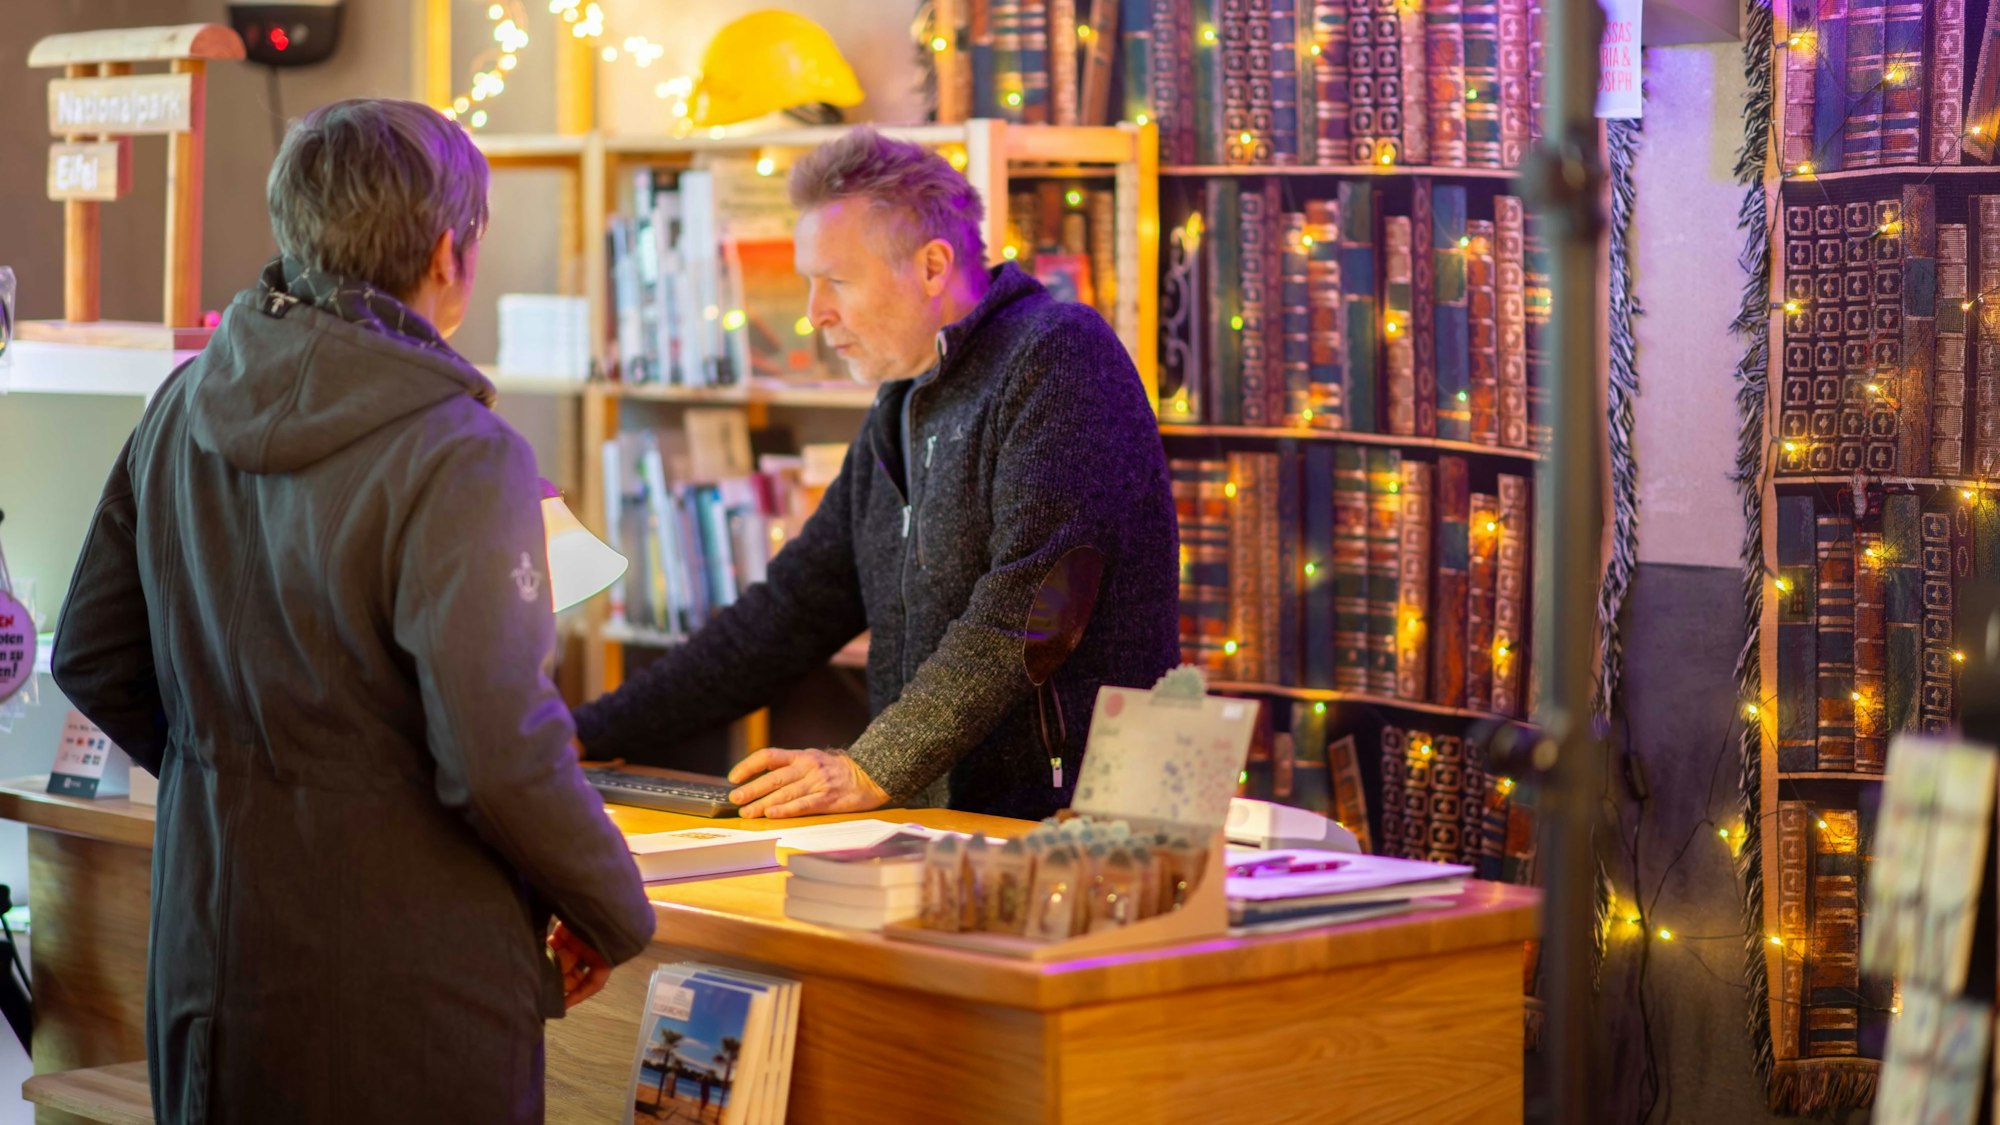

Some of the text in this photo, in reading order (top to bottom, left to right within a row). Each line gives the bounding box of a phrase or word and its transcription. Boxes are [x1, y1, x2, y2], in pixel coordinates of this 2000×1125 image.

[1622, 46, 1631, 67] &
[58, 89, 180, 126] Nationalpark
[56, 153, 97, 190] Eifel
[10, 650, 24, 662] zu
